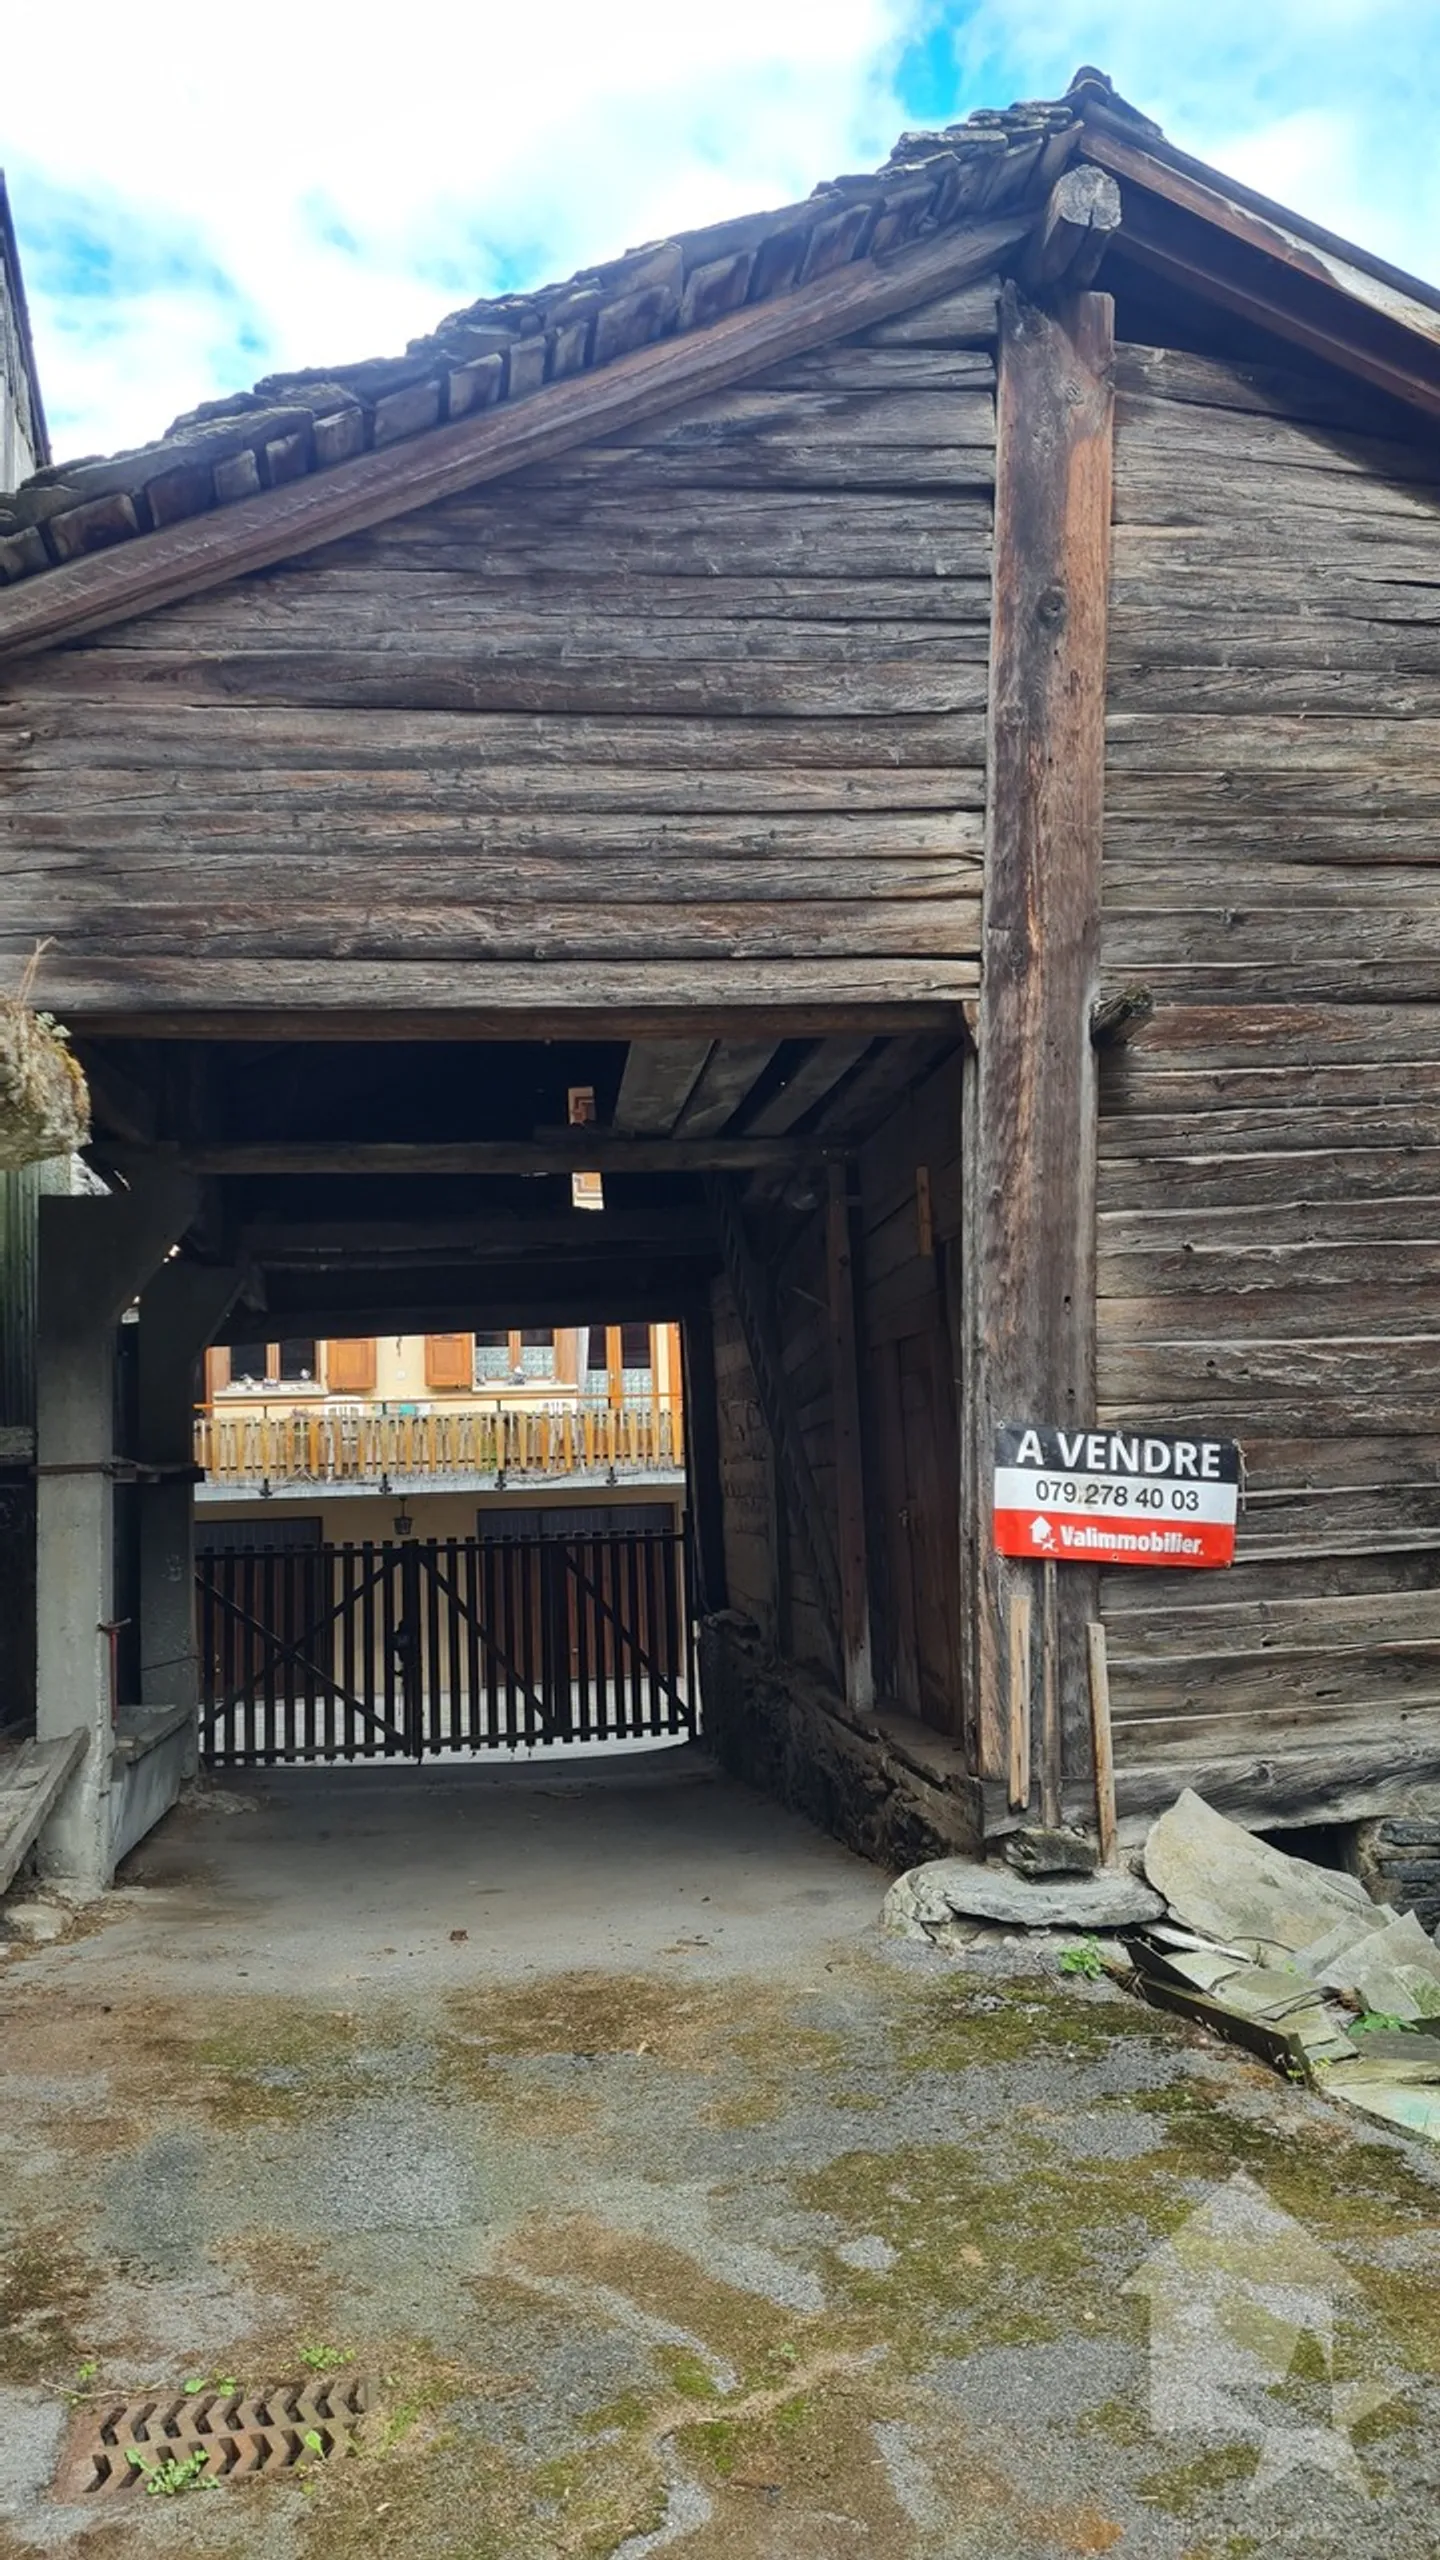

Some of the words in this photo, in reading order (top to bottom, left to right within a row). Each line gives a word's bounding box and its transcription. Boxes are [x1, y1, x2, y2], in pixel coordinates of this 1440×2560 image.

[1016, 1430, 1044, 1466] A
[1056, 1432, 1221, 1478] VENDRE
[1135, 1488, 1164, 1510] 40
[1171, 1490, 1199, 1511] 03
